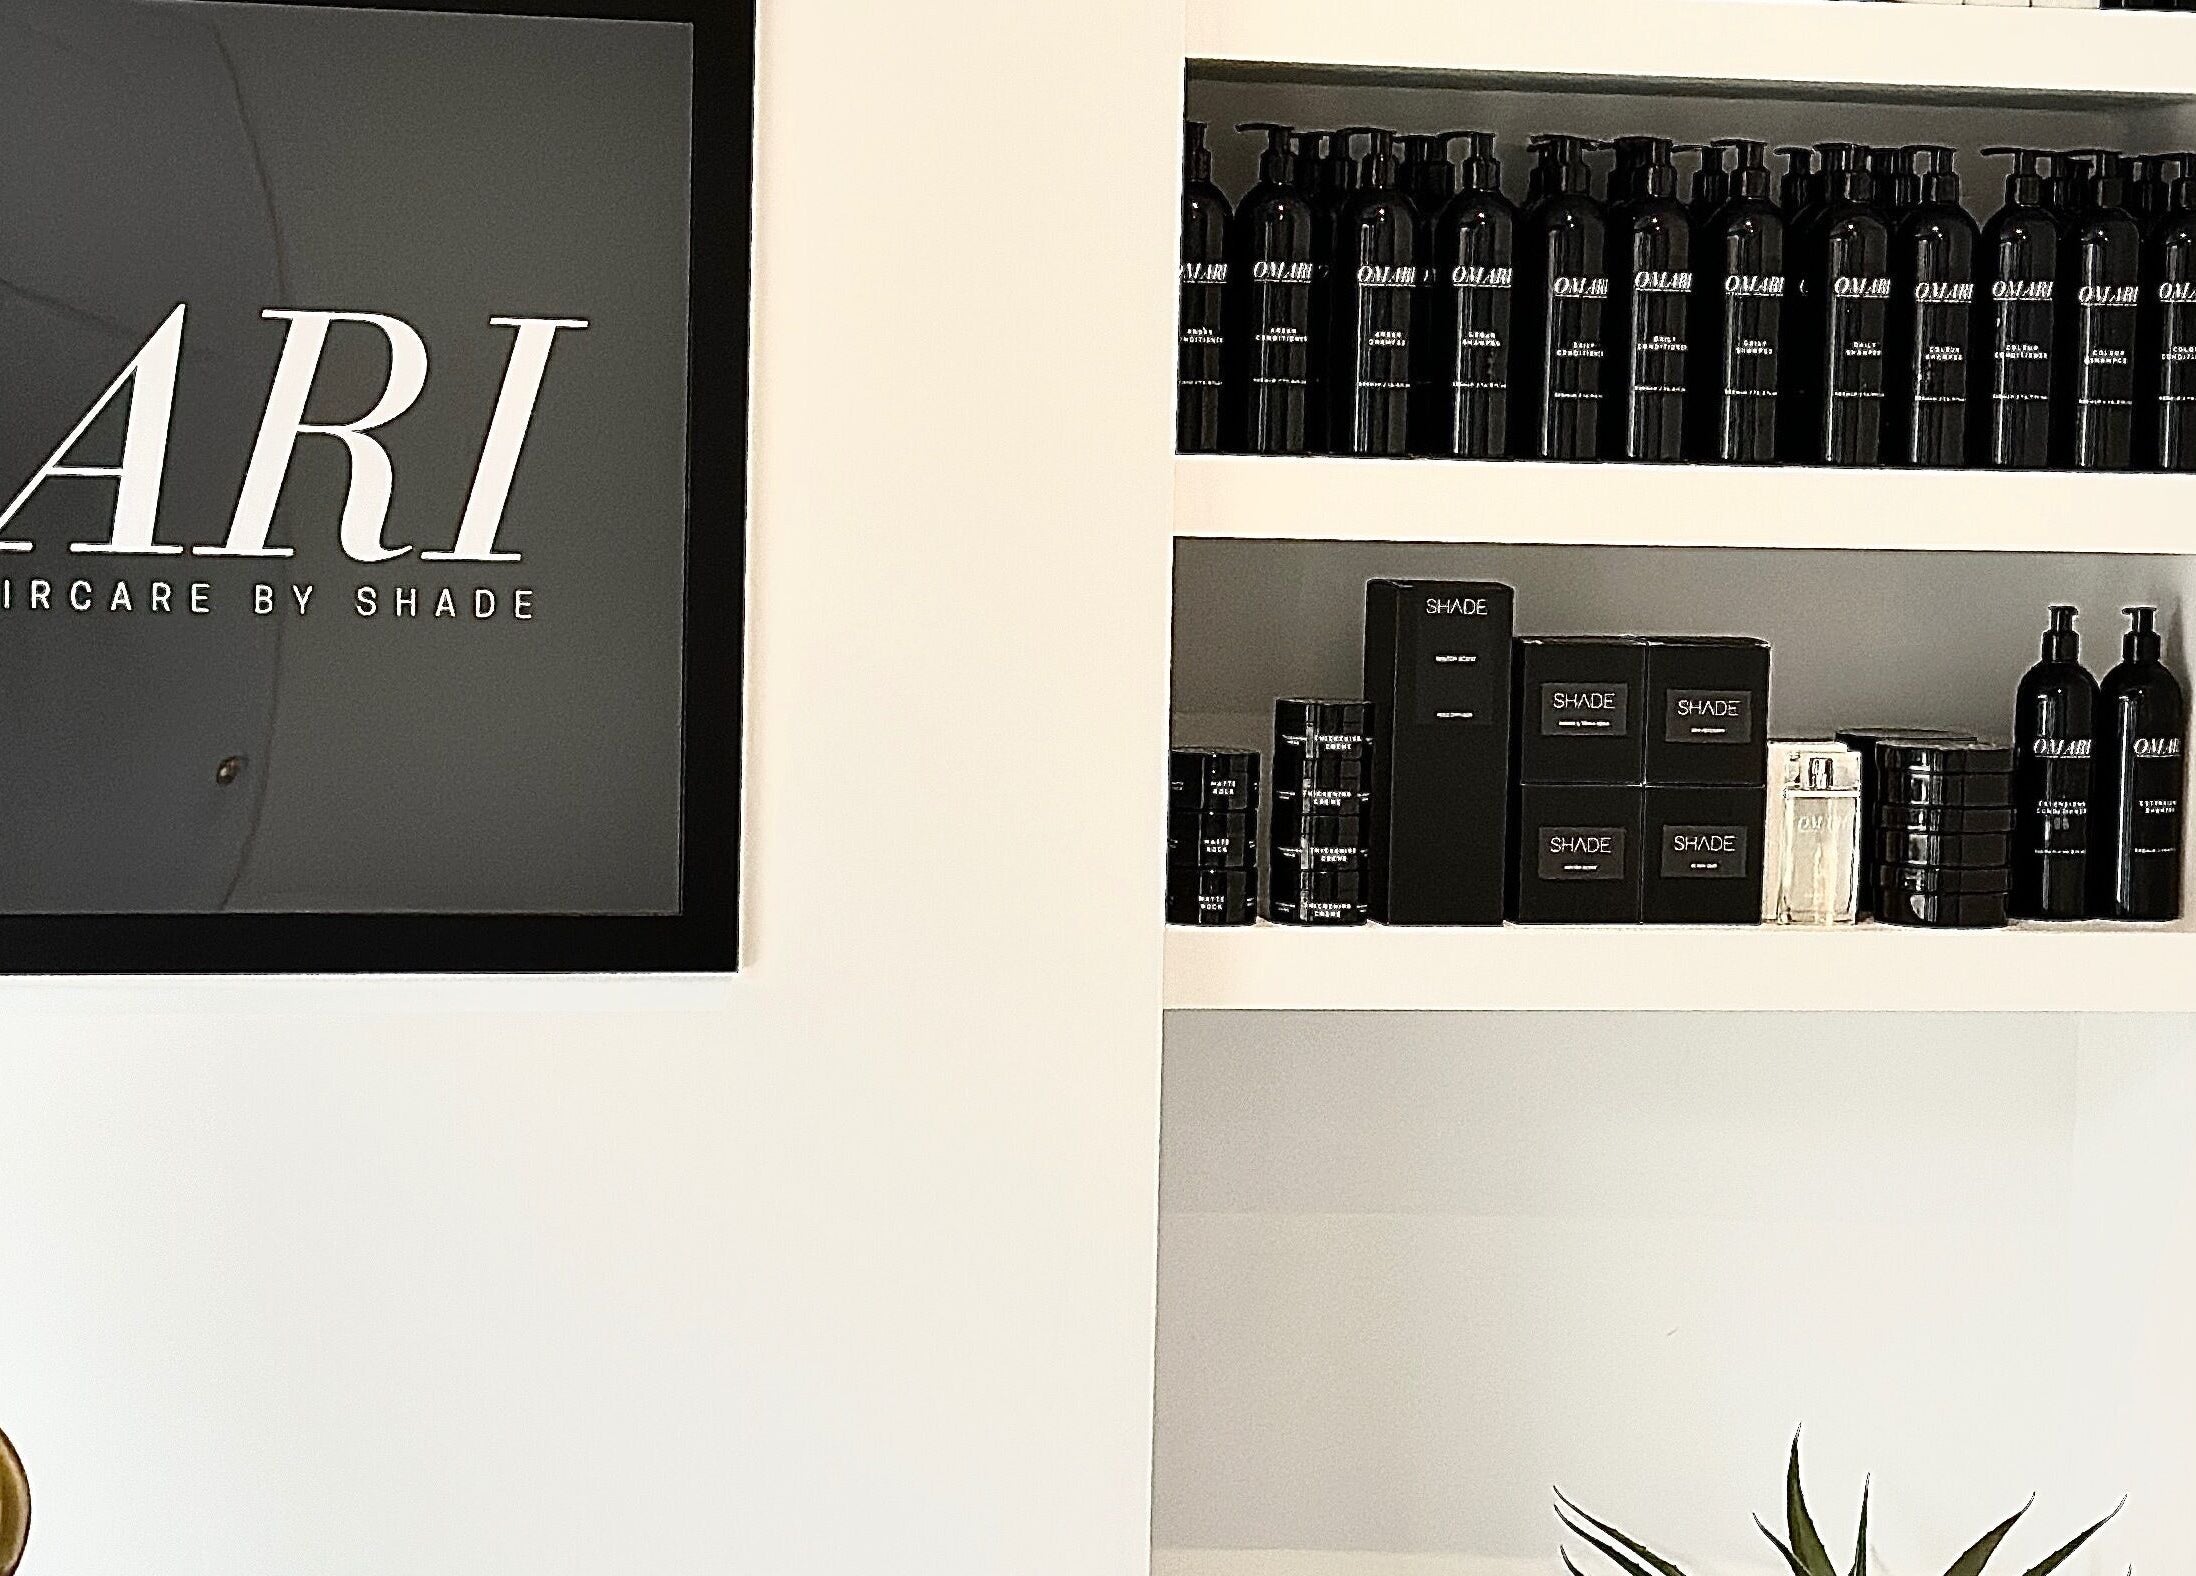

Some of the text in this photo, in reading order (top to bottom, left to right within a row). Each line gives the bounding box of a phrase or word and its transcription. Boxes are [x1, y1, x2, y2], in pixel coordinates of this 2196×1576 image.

[1180, 263, 1227, 280] MARI
[1253, 262, 1312, 279] OMARI
[1357, 266, 1416, 283] OMARI
[1452, 265, 1512, 284] OMARI
[1554, 277, 1609, 295] OMARI
[1634, 271, 1692, 289] OMARI
[1725, 275, 1785, 293] OMARI
[1834, 277, 1891, 294] OMARI
[1915, 282, 1974, 299] OMARI
[1992, 280, 2054, 298] OMARI
[2078, 286, 2139, 302] OMARI
[3, 577, 534, 619] IRCARE BY SHADE
[1426, 598, 1488, 615] SHADE
[1553, 692, 1616, 709] SHADE
[1677, 700, 1741, 716] SHADE
[2033, 738, 2092, 755] OMARI
[1550, 836, 1612, 853] SHADE
[1674, 835, 1738, 851] SHADE
